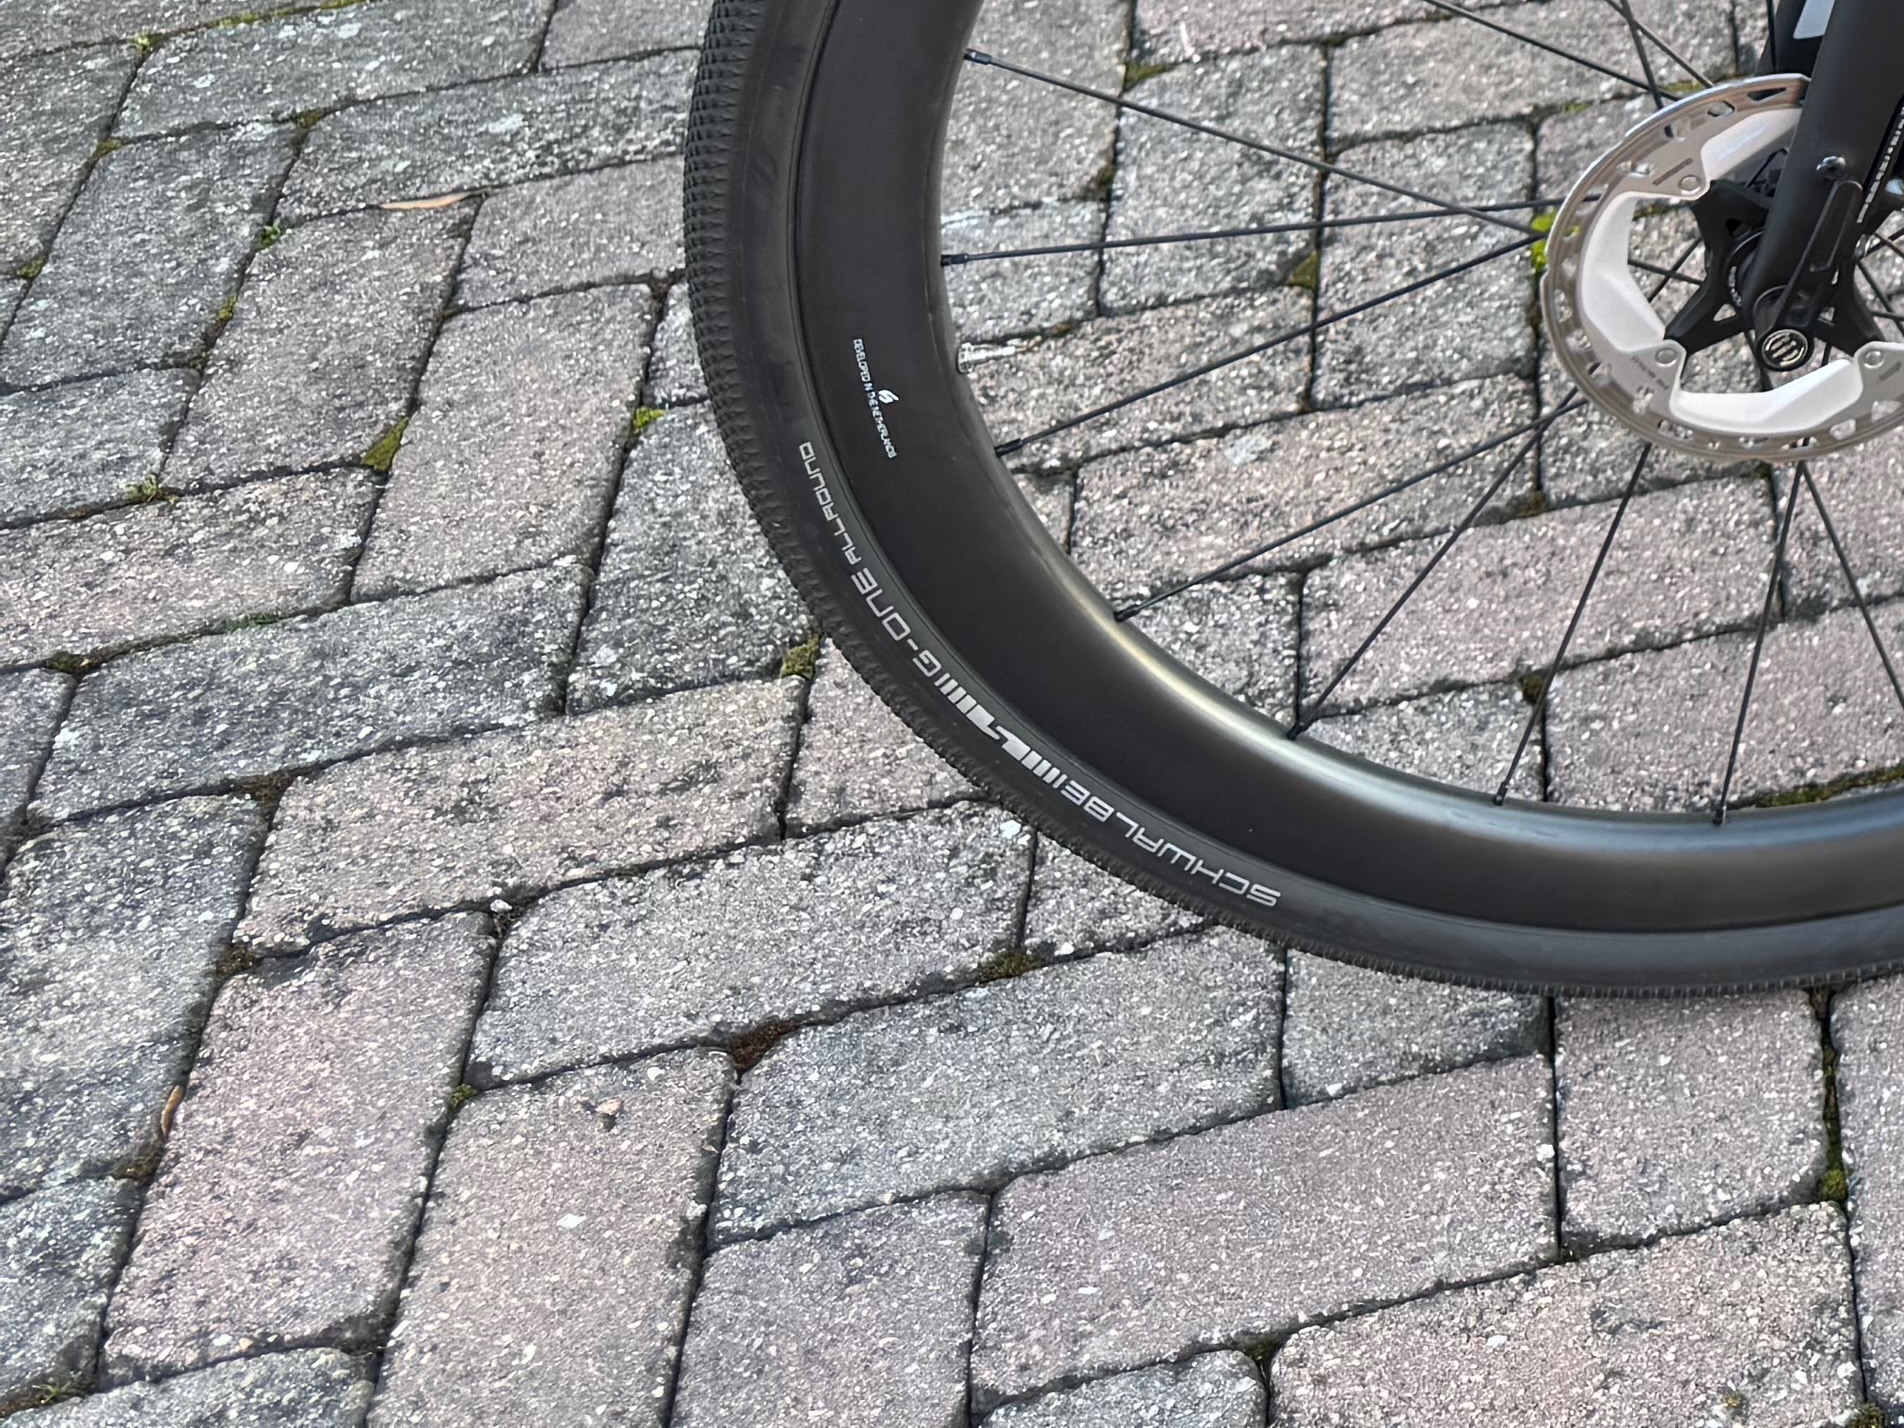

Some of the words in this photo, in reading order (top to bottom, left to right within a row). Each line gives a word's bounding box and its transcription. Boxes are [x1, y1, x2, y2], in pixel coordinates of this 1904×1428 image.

[799, 441, 862, 566] ALLROUND
[850, 567, 943, 677] G-ONE
[1061, 778, 1281, 908] SCHWALBE
